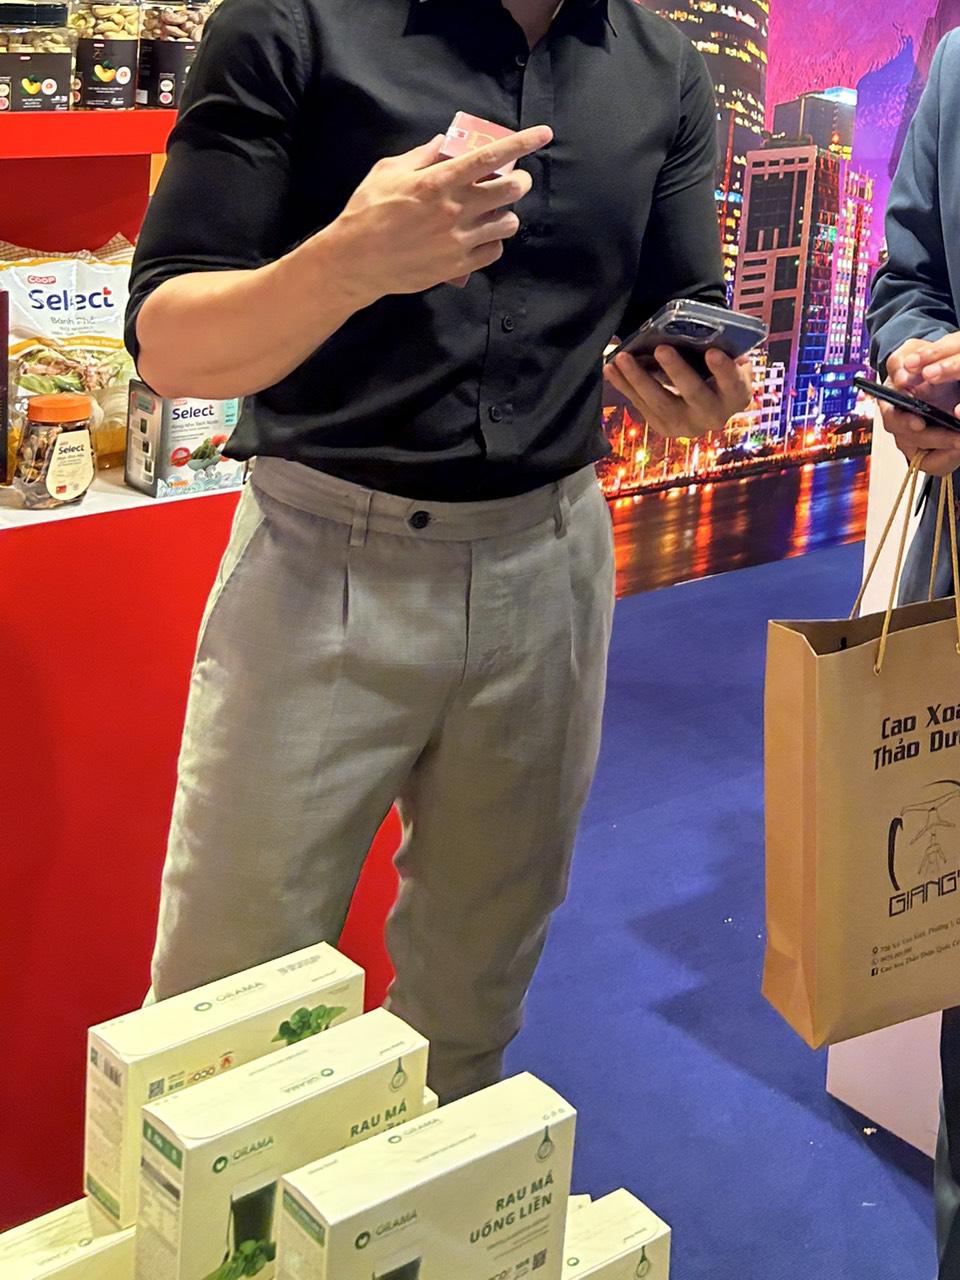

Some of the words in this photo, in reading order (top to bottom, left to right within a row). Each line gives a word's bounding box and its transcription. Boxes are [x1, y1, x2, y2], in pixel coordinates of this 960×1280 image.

[28, 287, 114, 311] Select
[172, 405, 215, 420] Select
[881, 715, 917, 740] Cao
[873, 737, 920, 771] Thảo
[350, 1114, 381, 1137] RAU
[384, 1098, 407, 1121] MÁ
[496, 1186, 527, 1212] RAU
[531, 1169, 554, 1194] MÁ
[470, 1212, 516, 1244] UỐNG
